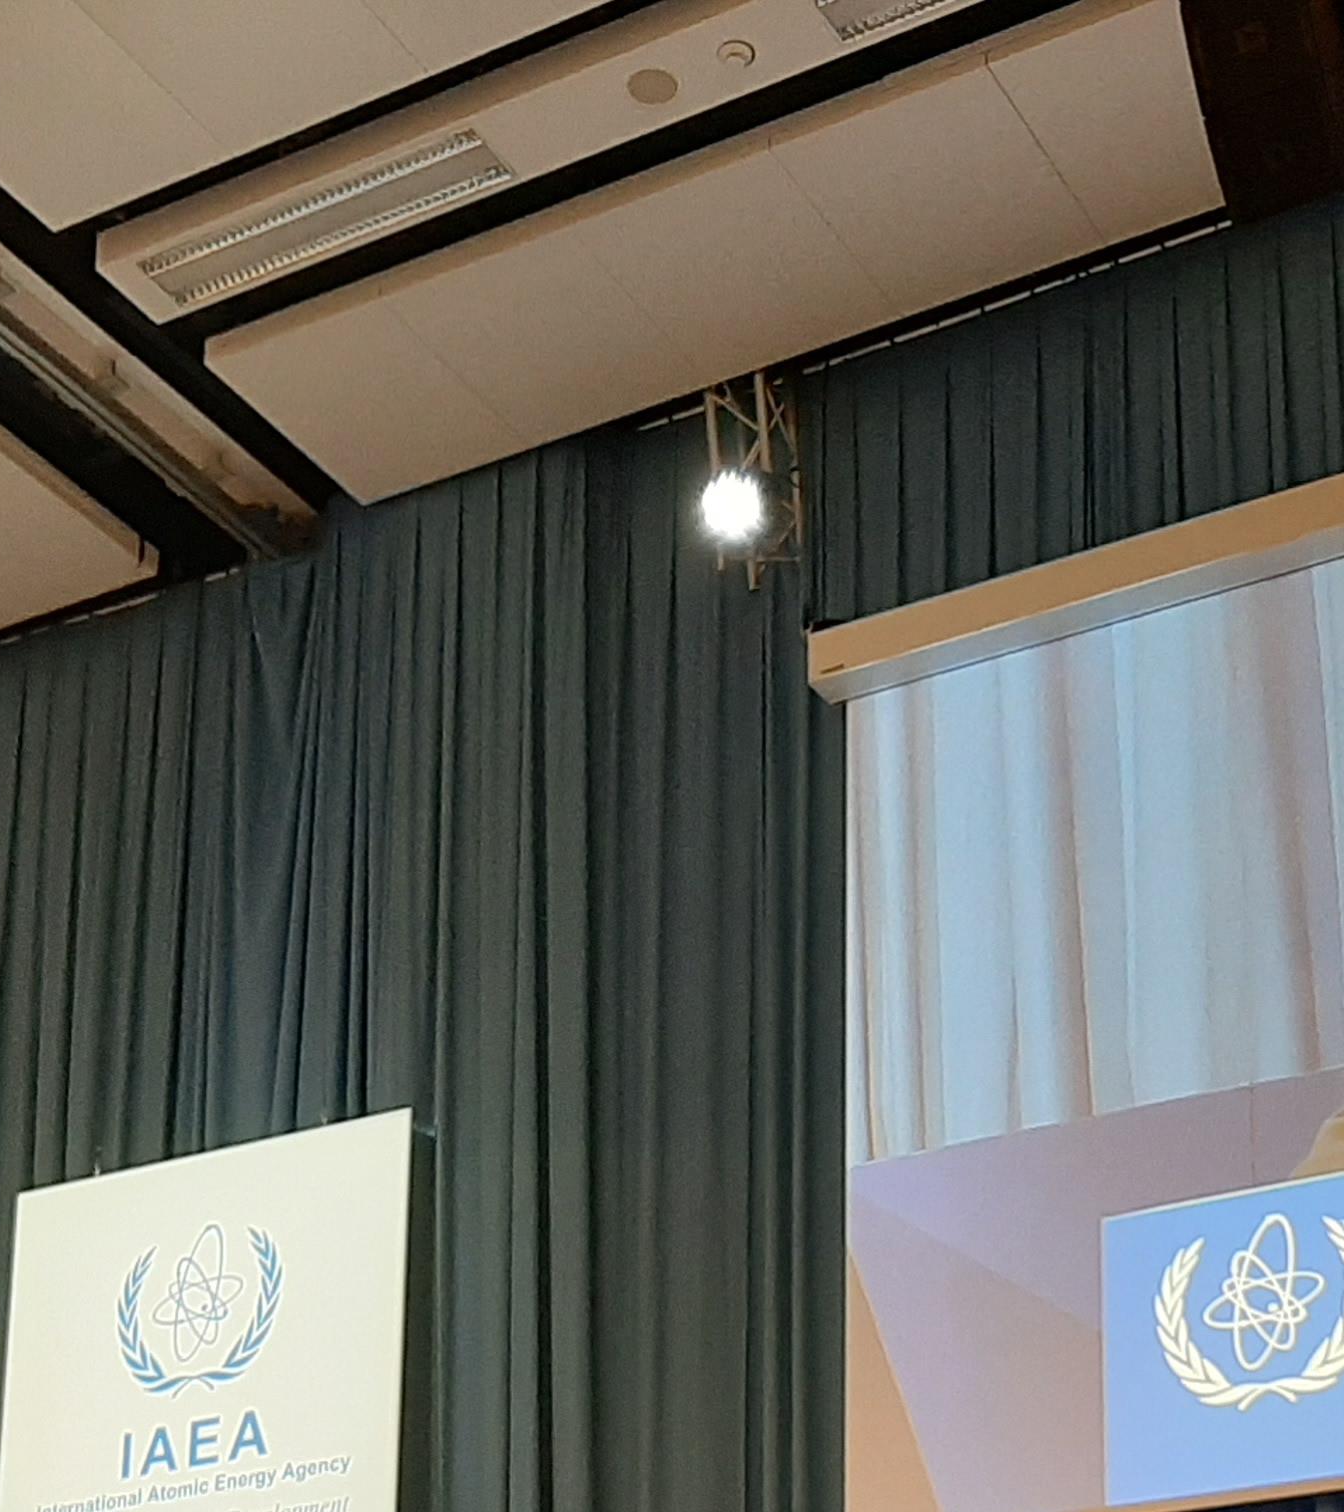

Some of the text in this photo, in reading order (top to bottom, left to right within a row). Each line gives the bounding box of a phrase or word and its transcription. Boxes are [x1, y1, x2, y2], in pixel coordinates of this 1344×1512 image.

[119, 1409, 269, 1480] IAEA
[148, 1477, 209, 1504] Atomic
[214, 1466, 278, 1490] Energy
[281, 1454, 352, 1485] Agency
